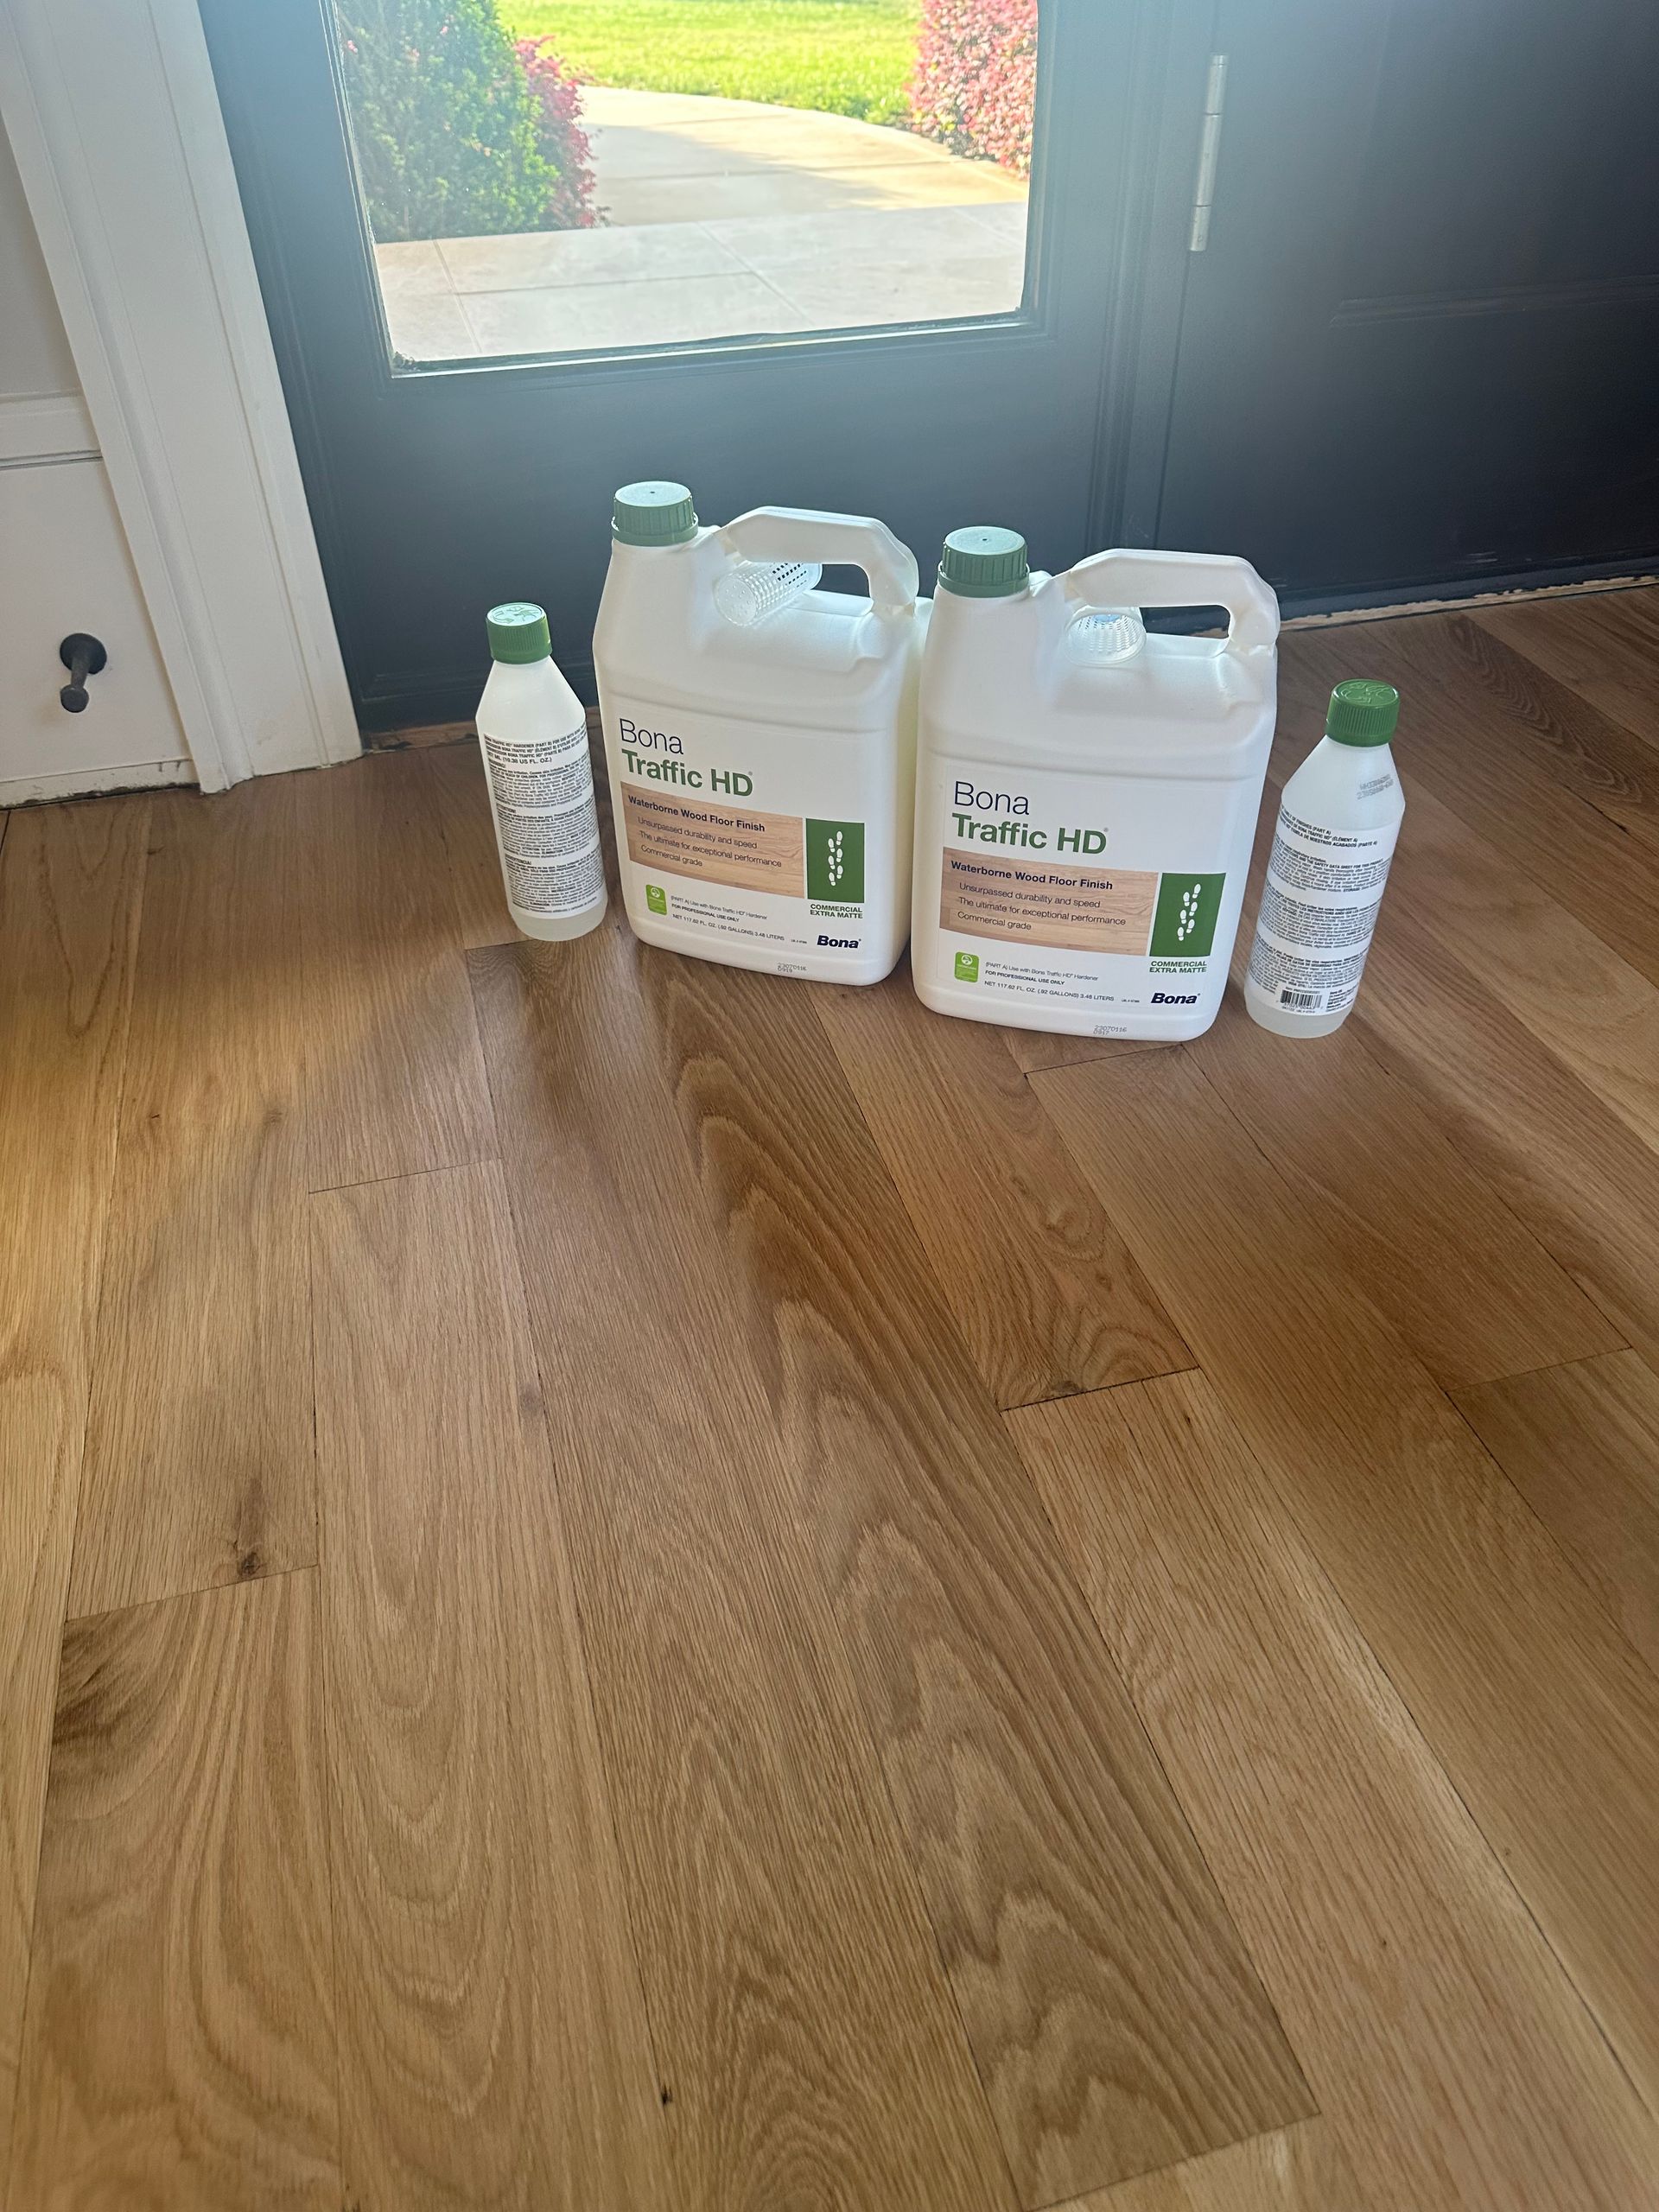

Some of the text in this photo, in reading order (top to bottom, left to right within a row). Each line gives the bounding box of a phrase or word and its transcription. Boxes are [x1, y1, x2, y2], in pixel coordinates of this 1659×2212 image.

[620, 718, 683, 754] Bona
[621, 748, 702, 788] Traffic
[954, 781, 1029, 816] Bona
[628, 794, 766, 832] Waterborne Wood Floor Finish
[638, 817, 758, 850] Unsurpassed durability and speed
[952, 812, 1047, 849] Traffic
[639, 830, 782, 868] The ultimate for exceptional performance
[641, 844, 703, 868] Commercial grade
[950, 860, 1113, 890] Waterborne Wood Floor Finish
[810, 904, 862, 912] COMMERCIAL
[959, 882, 1101, 908] Unsurpassed durability and speed
[682, 906, 715, 918] PROFESSIONAL
[810, 909, 836, 918] EXTRA
[957, 911, 1032, 931] Commercial grade
[958, 897, 974, 906] The
[976, 899, 1007, 912] ultimate
[1022, 907, 1070, 921] exceptional
[1071, 913, 1126, 925] performance
[728, 926, 753, 936] GALLONS)
[997, 972, 1037, 982] PROFESSIONAL
[1049, 989, 1079, 999] GALLONS)
